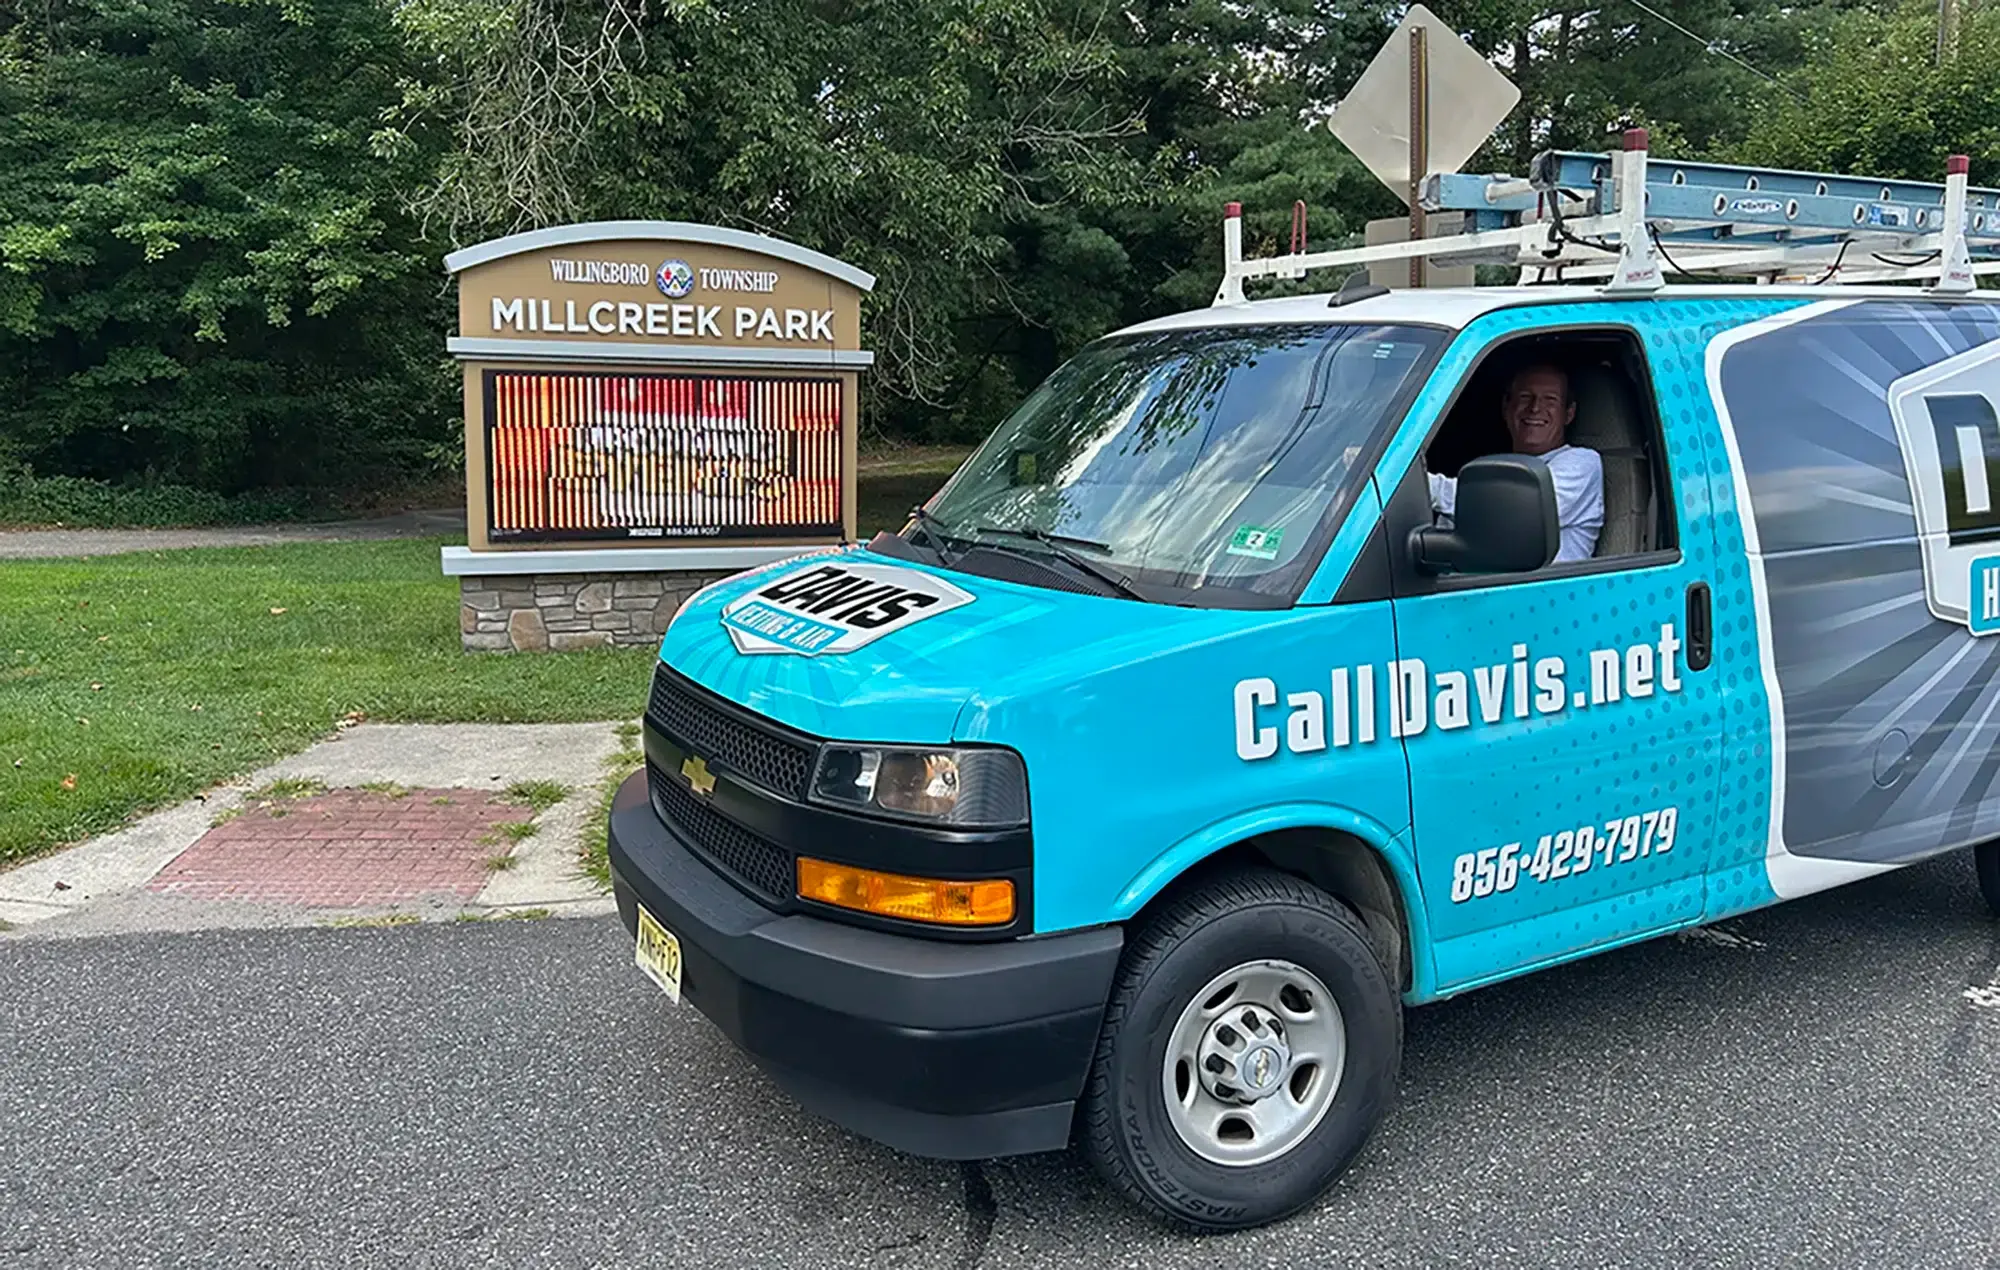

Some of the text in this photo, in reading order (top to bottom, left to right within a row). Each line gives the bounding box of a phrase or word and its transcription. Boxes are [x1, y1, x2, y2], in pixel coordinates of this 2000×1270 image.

[551, 259, 649, 286] WILLINGBORO
[700, 268, 779, 292] TOWNSHIP
[492, 297, 835, 341] MILLCREEK PARK
[758, 566, 940, 629] DAVIS
[791, 625, 836, 649] AIR
